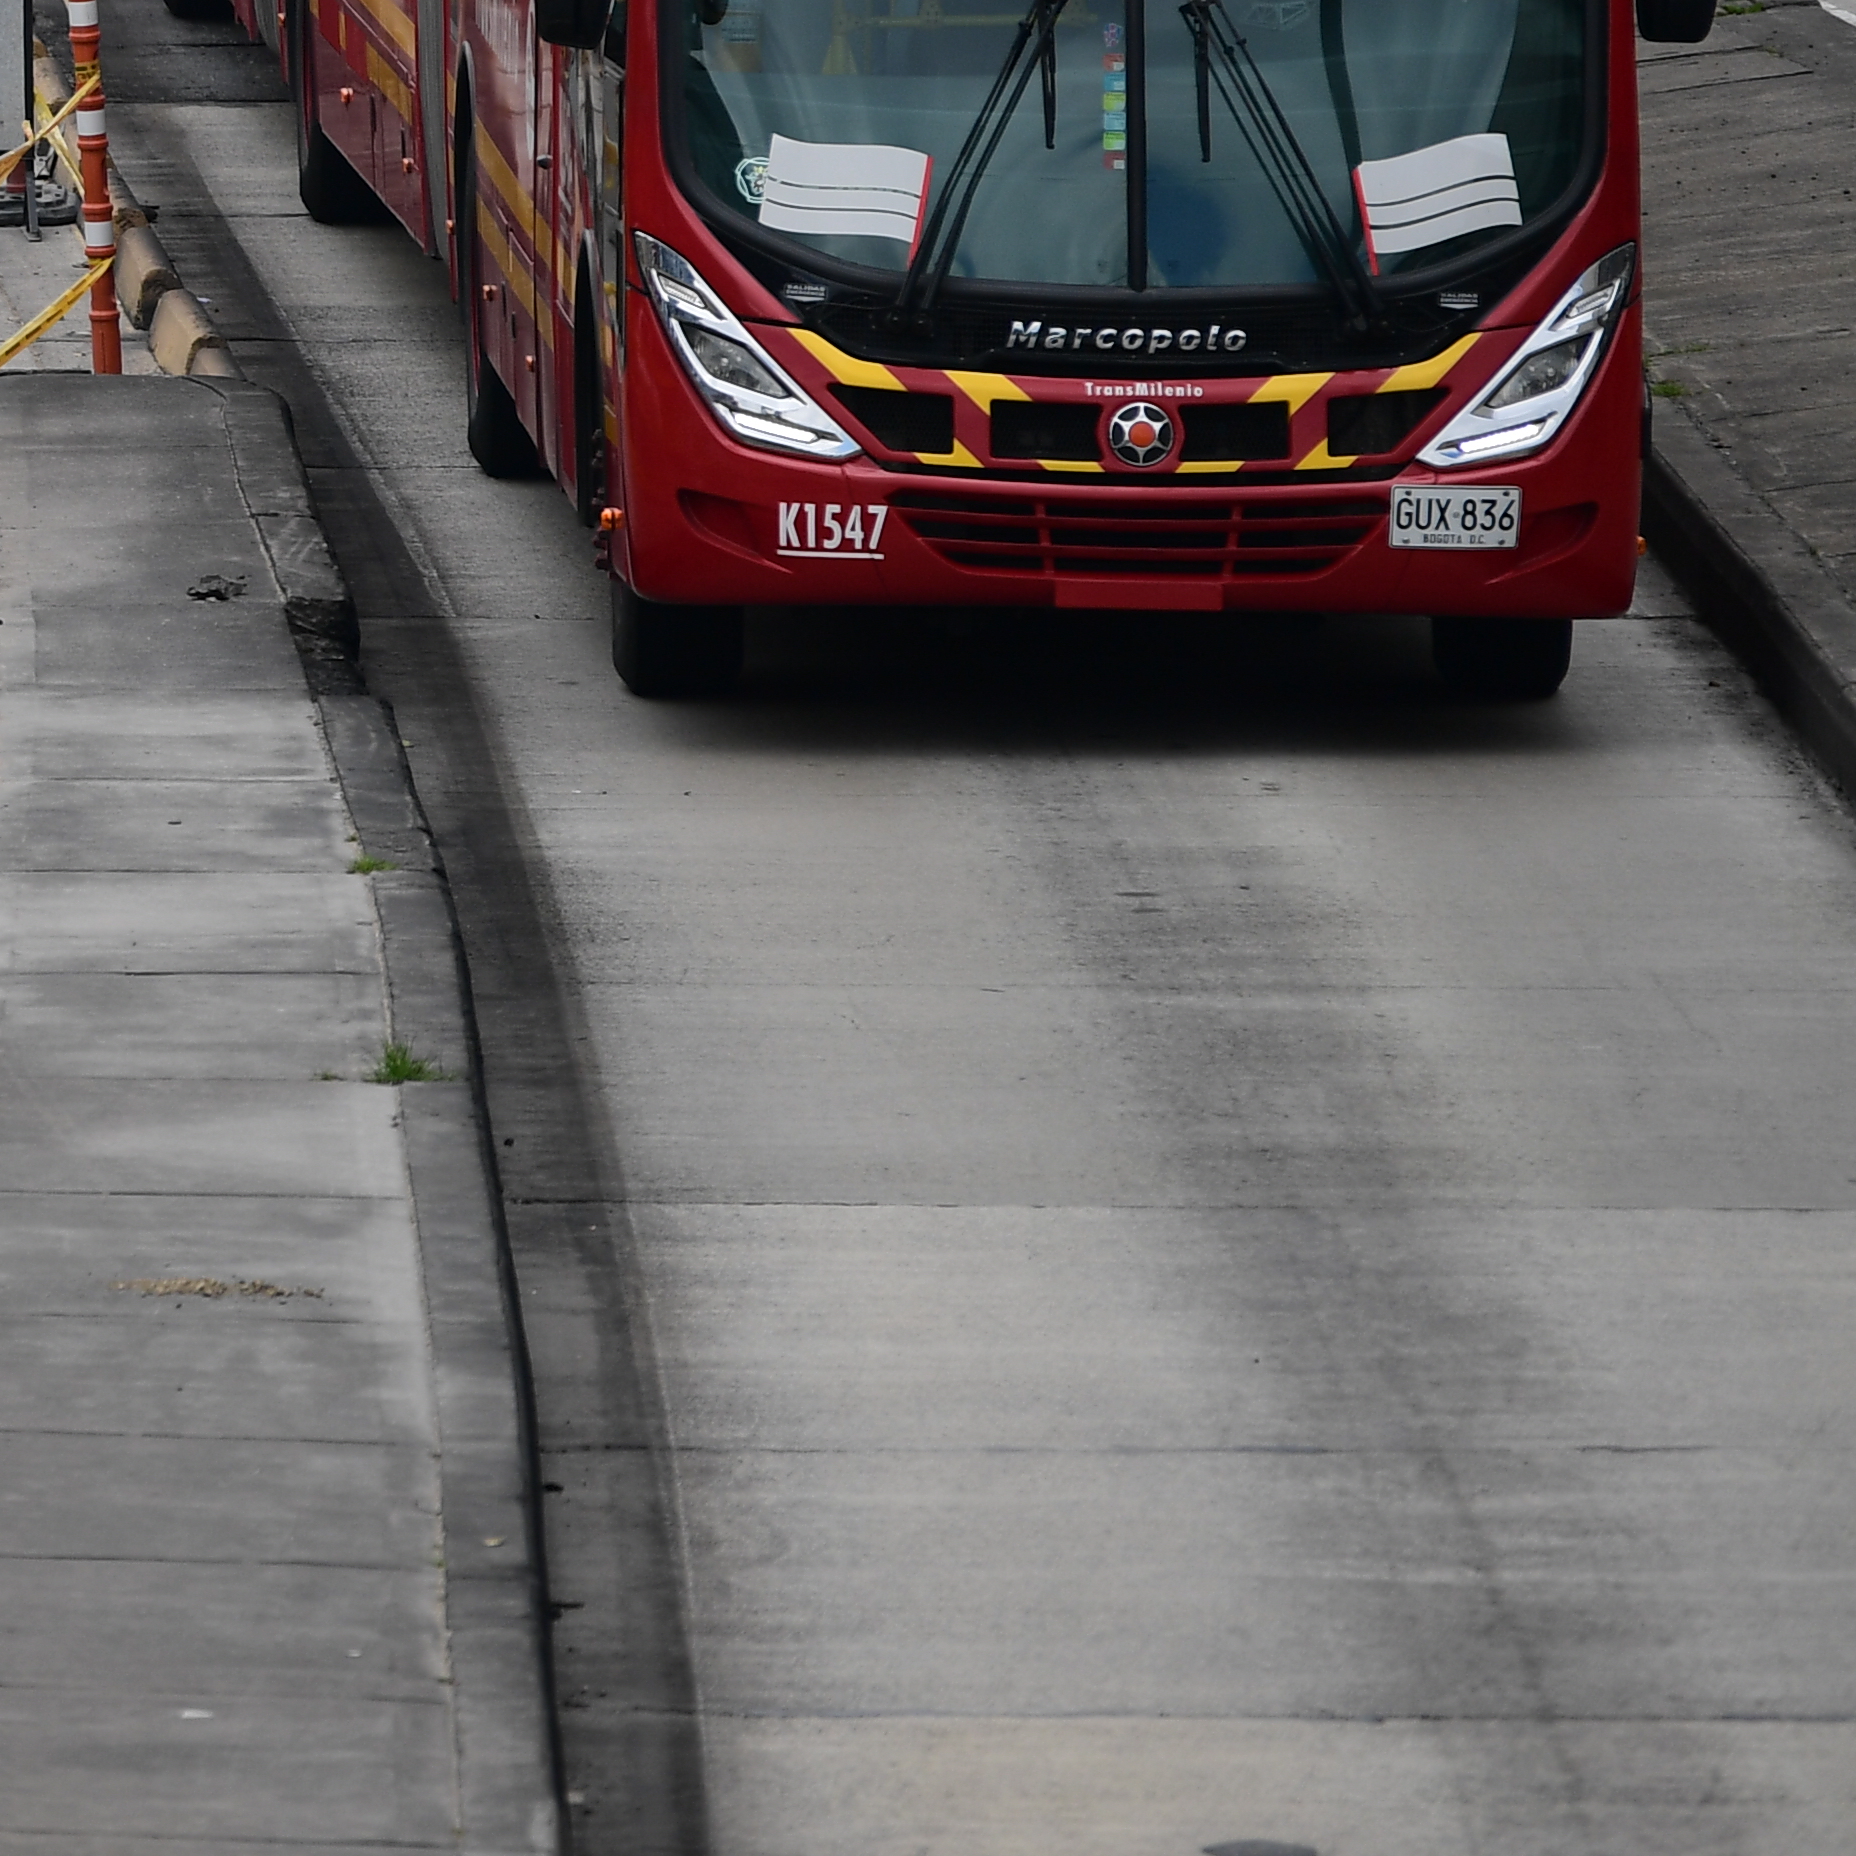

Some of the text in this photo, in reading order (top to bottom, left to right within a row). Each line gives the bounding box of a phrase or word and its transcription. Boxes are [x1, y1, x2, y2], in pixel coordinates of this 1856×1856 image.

[1008, 319, 1248, 354] Marcopolo
[1084, 381, 1206, 398] TransMilenio
[777, 502, 890, 549] K1547
[1395, 498, 1516, 532] GUX 836
[1423, 532, 1463, 545] BOGOTA
